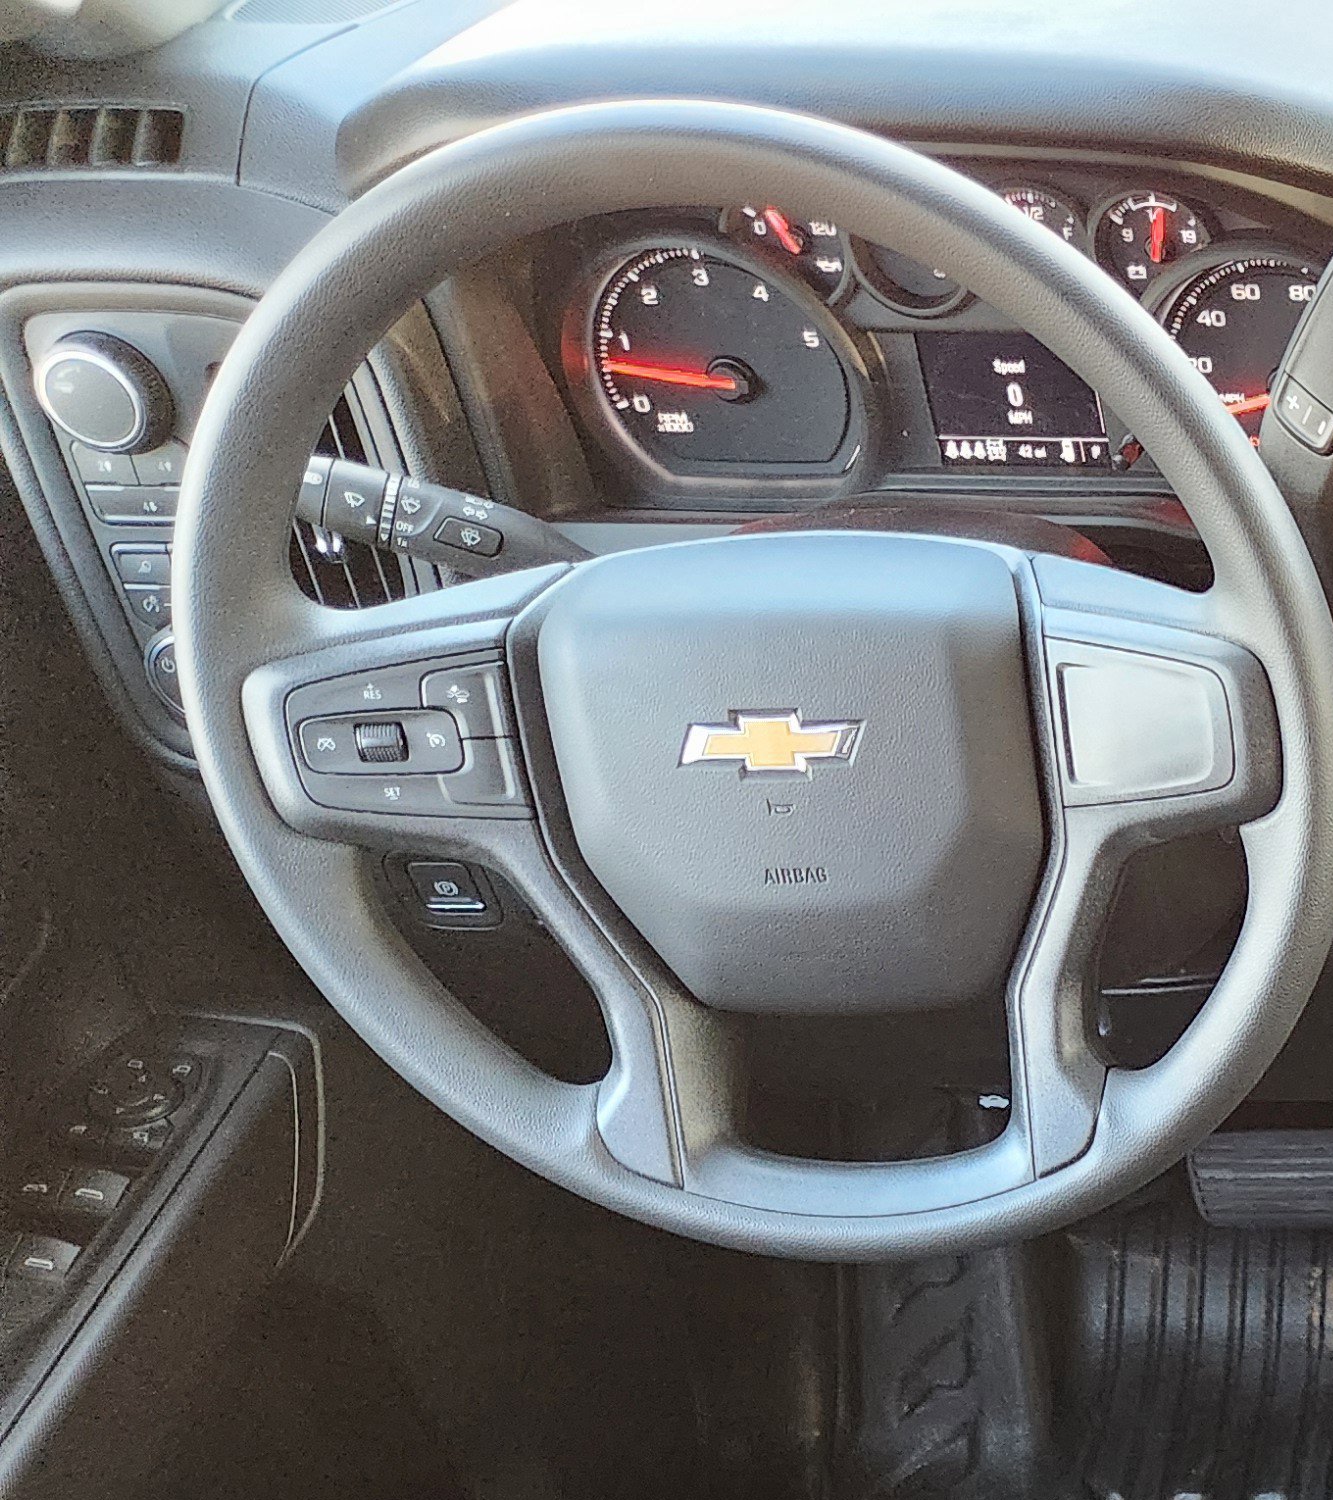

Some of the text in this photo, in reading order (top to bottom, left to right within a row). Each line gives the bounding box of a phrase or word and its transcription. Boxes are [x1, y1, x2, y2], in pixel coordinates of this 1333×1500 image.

[692, 268, 709, 286] 3
[641, 287, 658, 305] 2
[753, 284, 769, 301] 4
[1231, 284, 1260, 300] 60
[1196, 310, 1226, 327] 40
[619, 332, 630, 351] 1
[803, 330, 820, 347] 5
[992, 358, 1025, 375] Speed
[1007, 382, 1023, 407] 0
[633, 394, 650, 413] 0
[1008, 410, 1033, 424] MPH
[396, 521, 414, 533] OFF
[363, 690, 382, 700] RES
[384, 787, 400, 798] SET
[764, 867, 828, 885] AIRBAG
